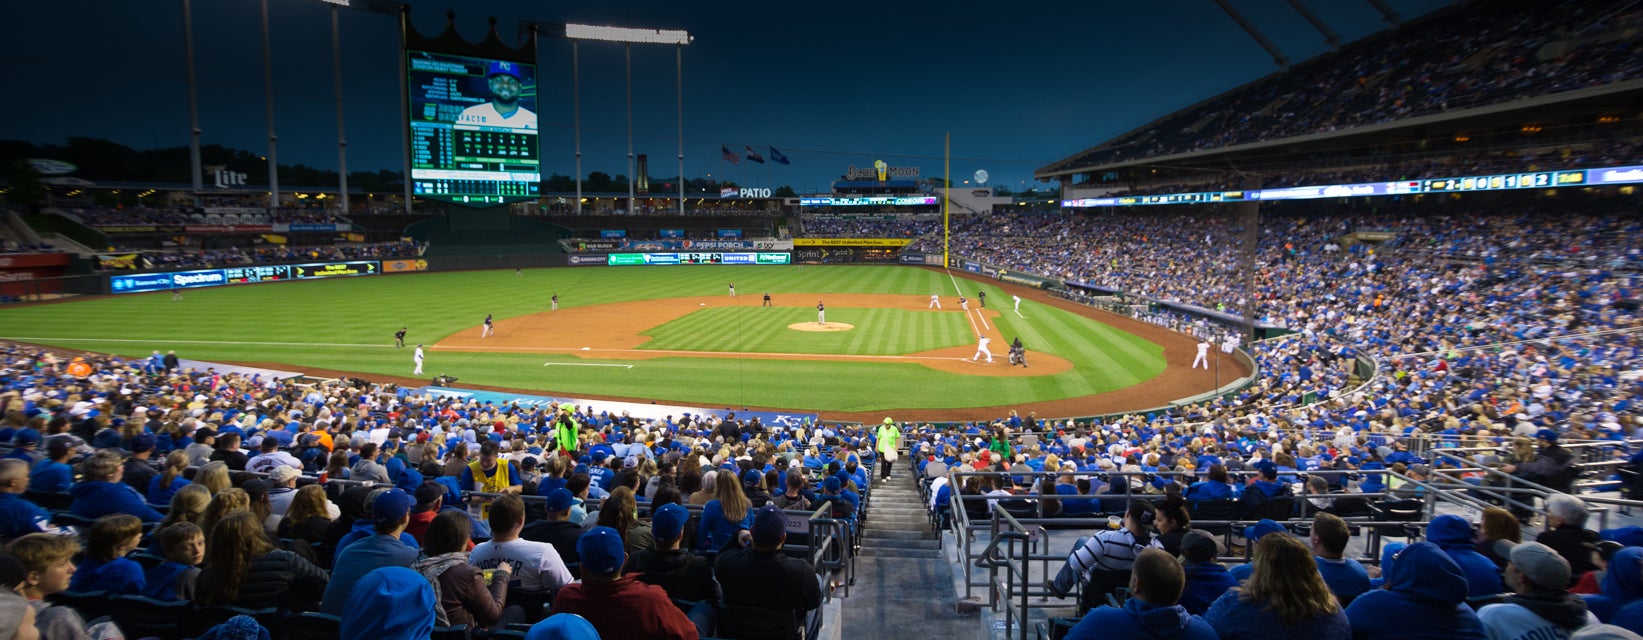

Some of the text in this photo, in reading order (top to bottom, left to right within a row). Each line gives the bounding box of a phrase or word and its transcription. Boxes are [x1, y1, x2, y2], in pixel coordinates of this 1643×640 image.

[847, 165, 920, 180] BLUE MOON
[214, 169, 248, 188] Lite
[740, 188, 772, 198] PATIO
[798, 250, 820, 258] Sprint
[174, 274, 222, 285] Spectrum
[788, 520, 802, 528] 223
[476, 558, 523, 576] HOSR
